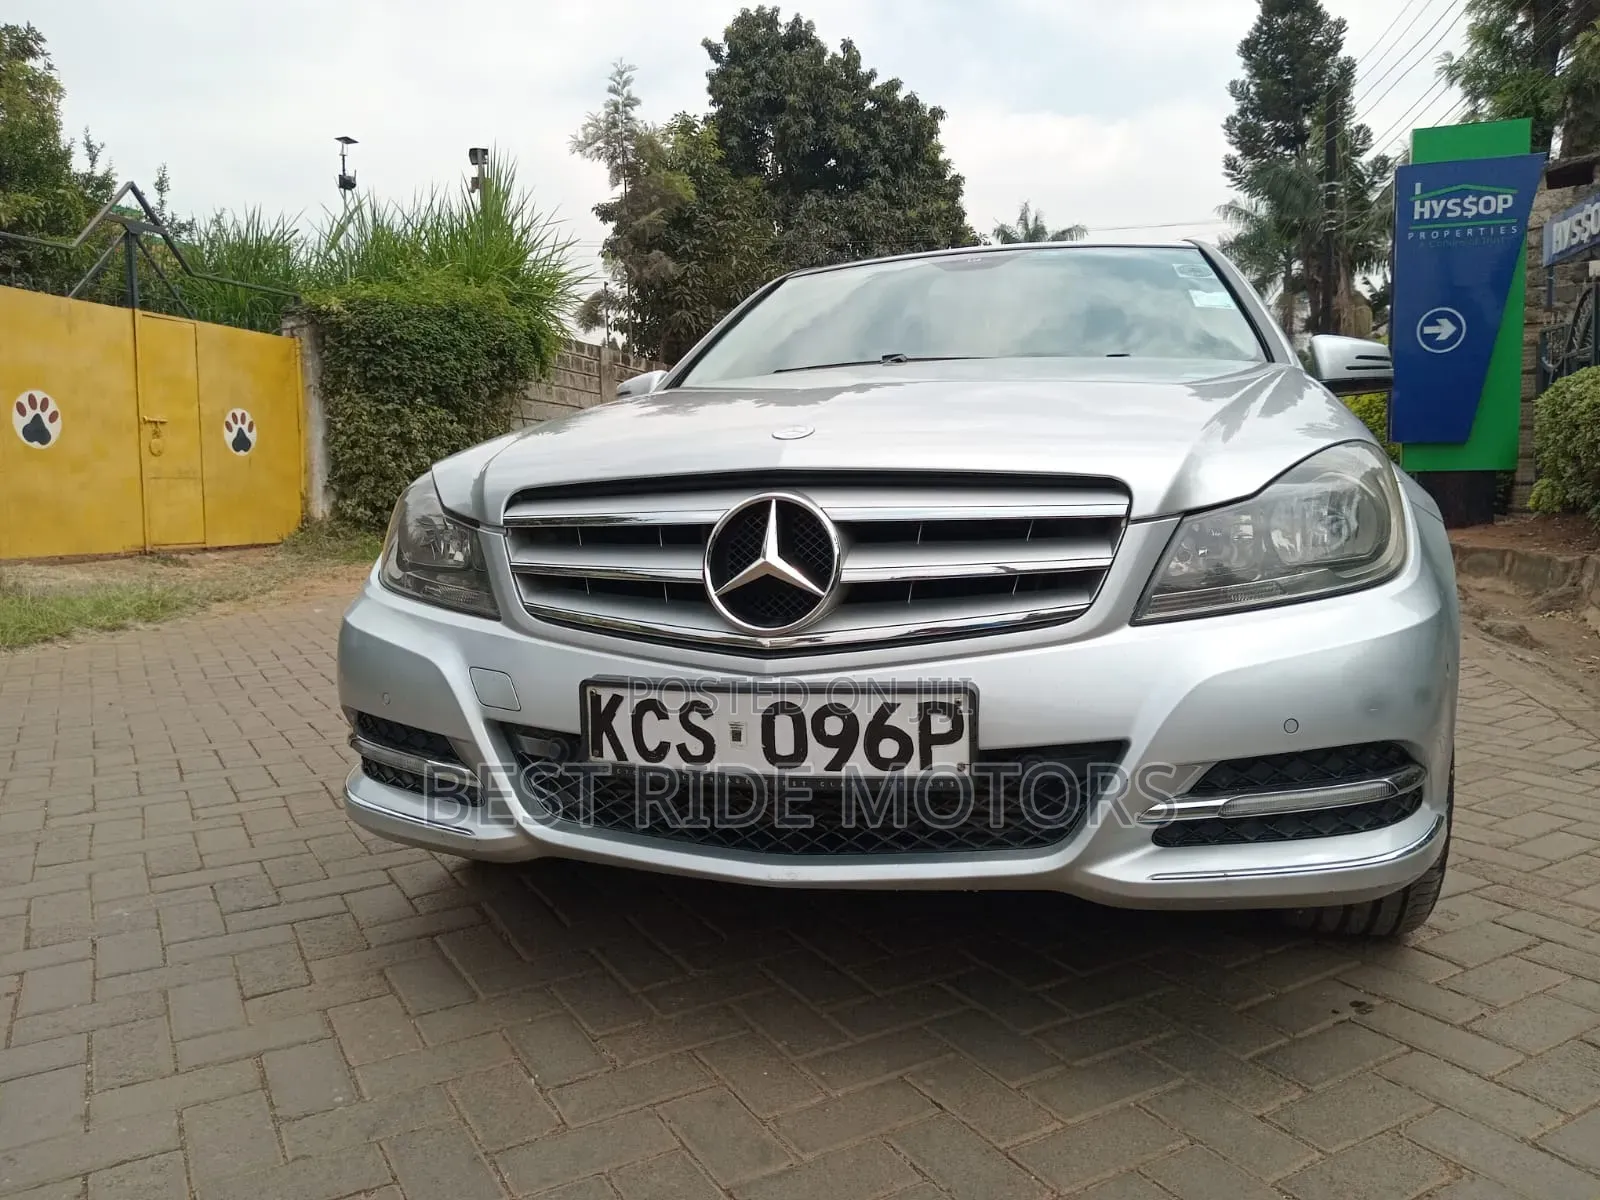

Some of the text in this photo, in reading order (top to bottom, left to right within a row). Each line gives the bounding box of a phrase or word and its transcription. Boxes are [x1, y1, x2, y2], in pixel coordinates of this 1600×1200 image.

[1408, 226, 1517, 240] PROPERTIES
[591, 693, 964, 772] KCS 096P
